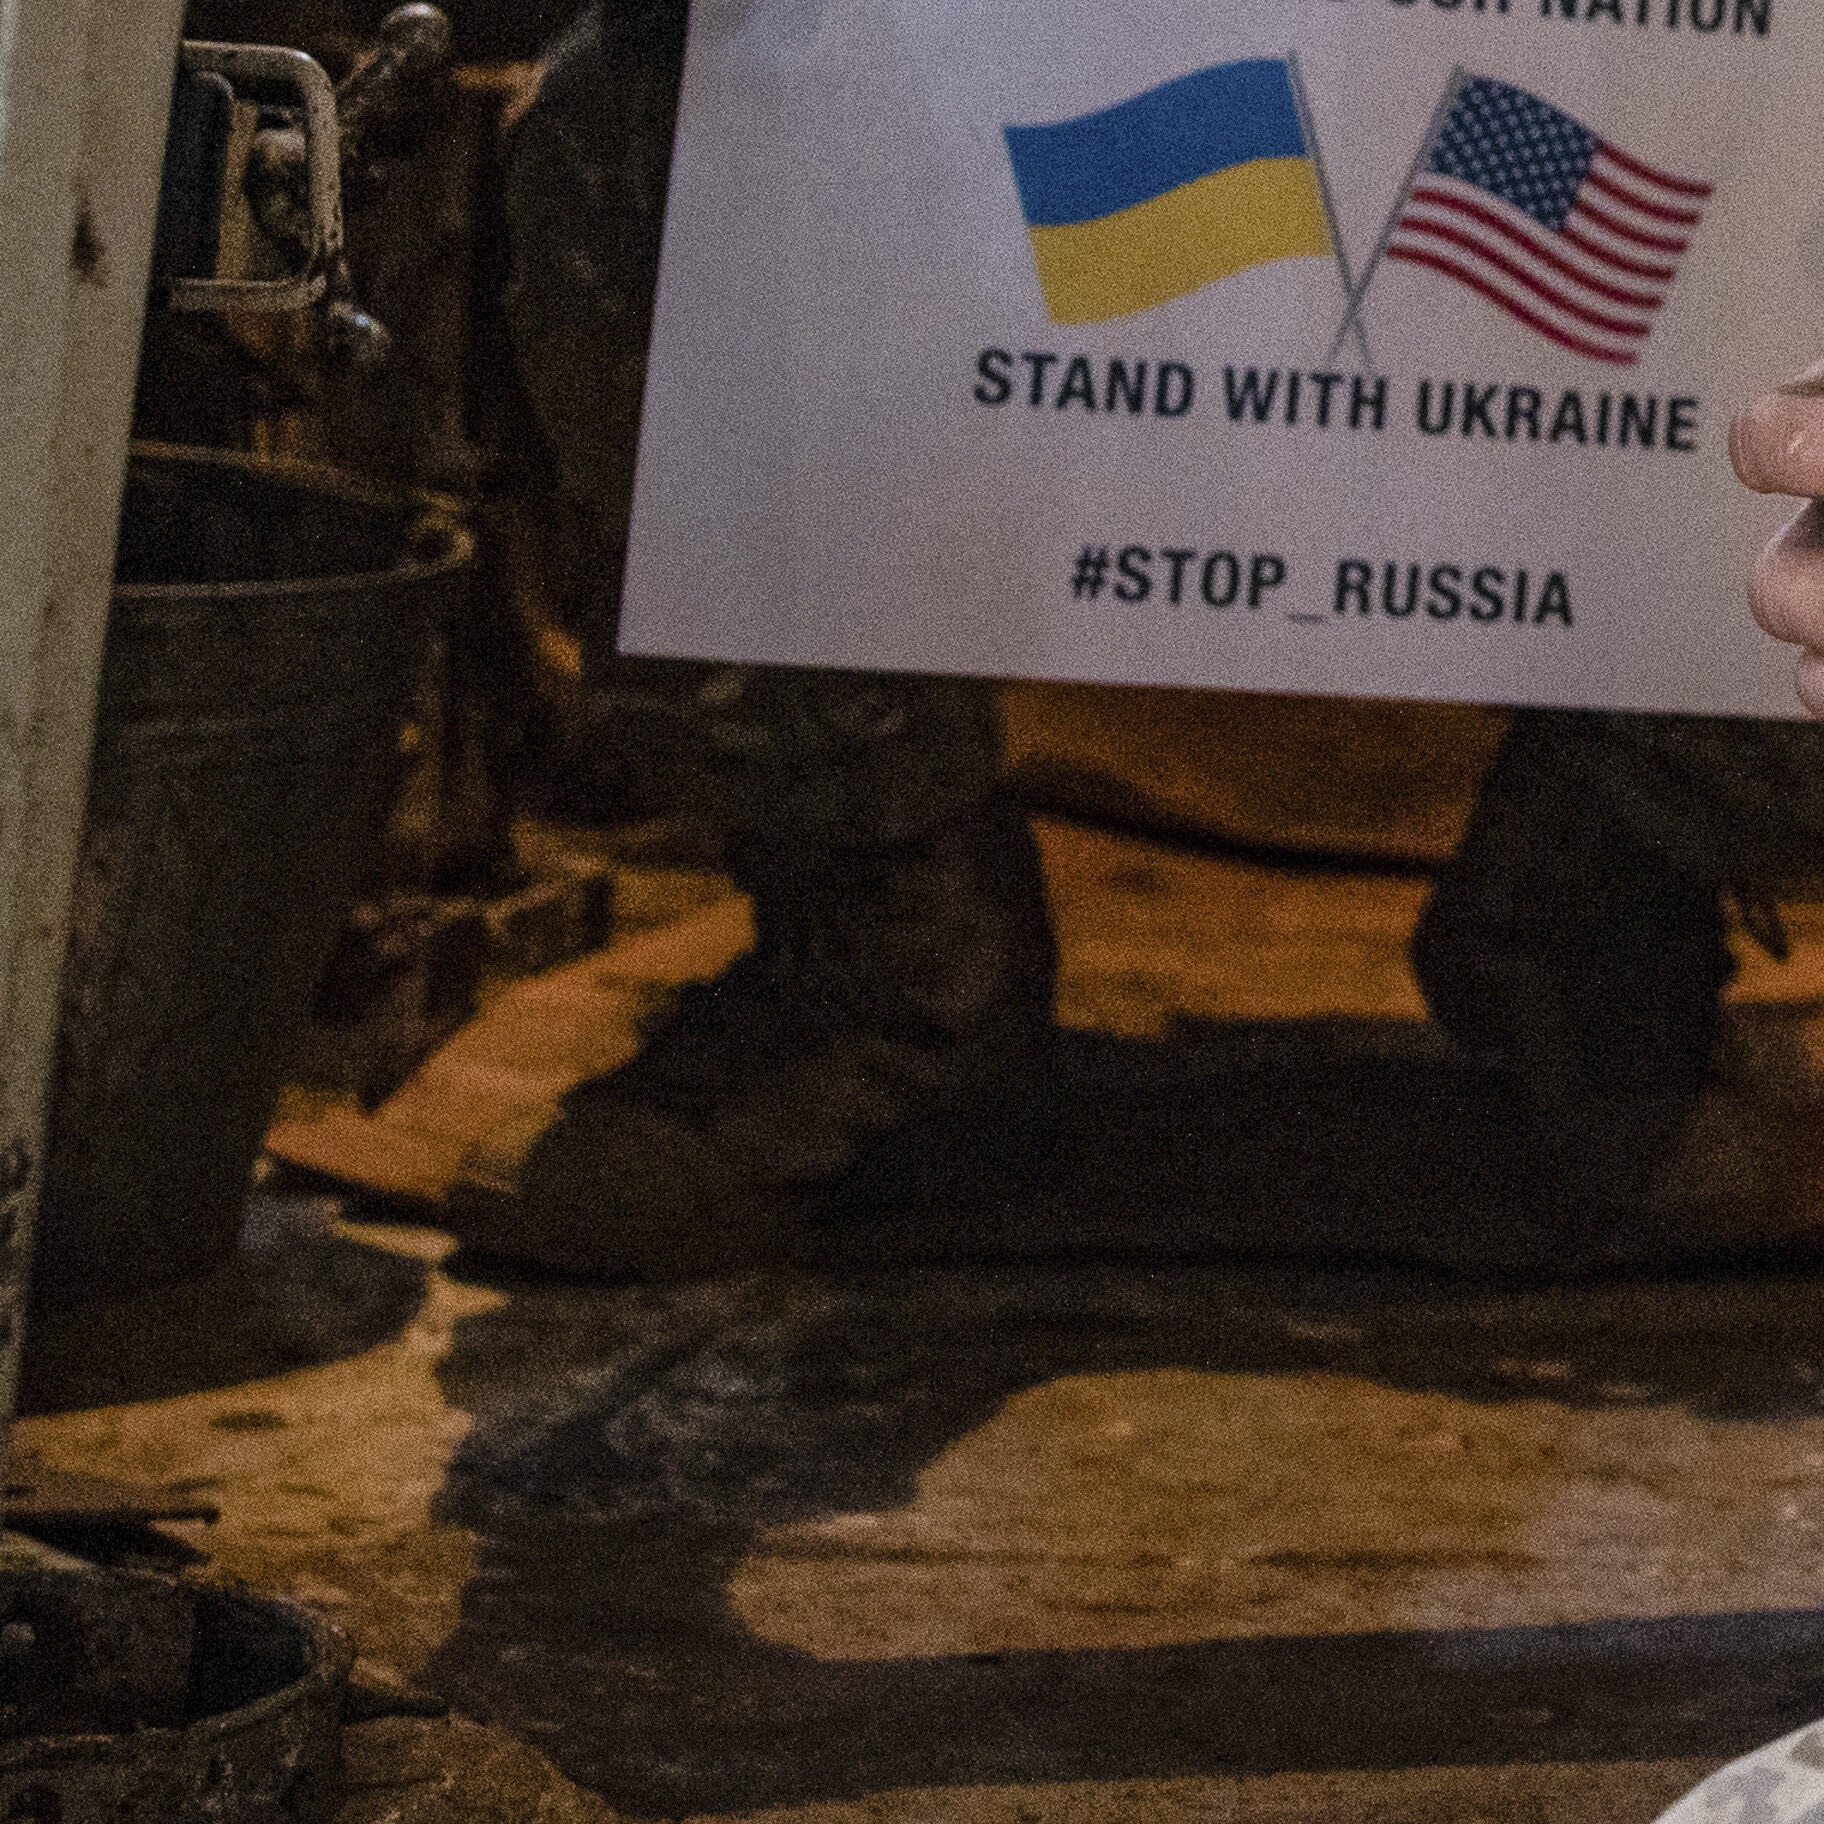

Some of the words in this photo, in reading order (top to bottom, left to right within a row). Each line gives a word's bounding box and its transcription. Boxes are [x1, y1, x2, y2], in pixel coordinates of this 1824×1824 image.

[972, 347, 1196, 419] STAND
[1222, 365, 1390, 432] WITH
[1415, 378, 1699, 454] UKRAINE
[1070, 544, 1575, 628] #STOP_RUSSIA
